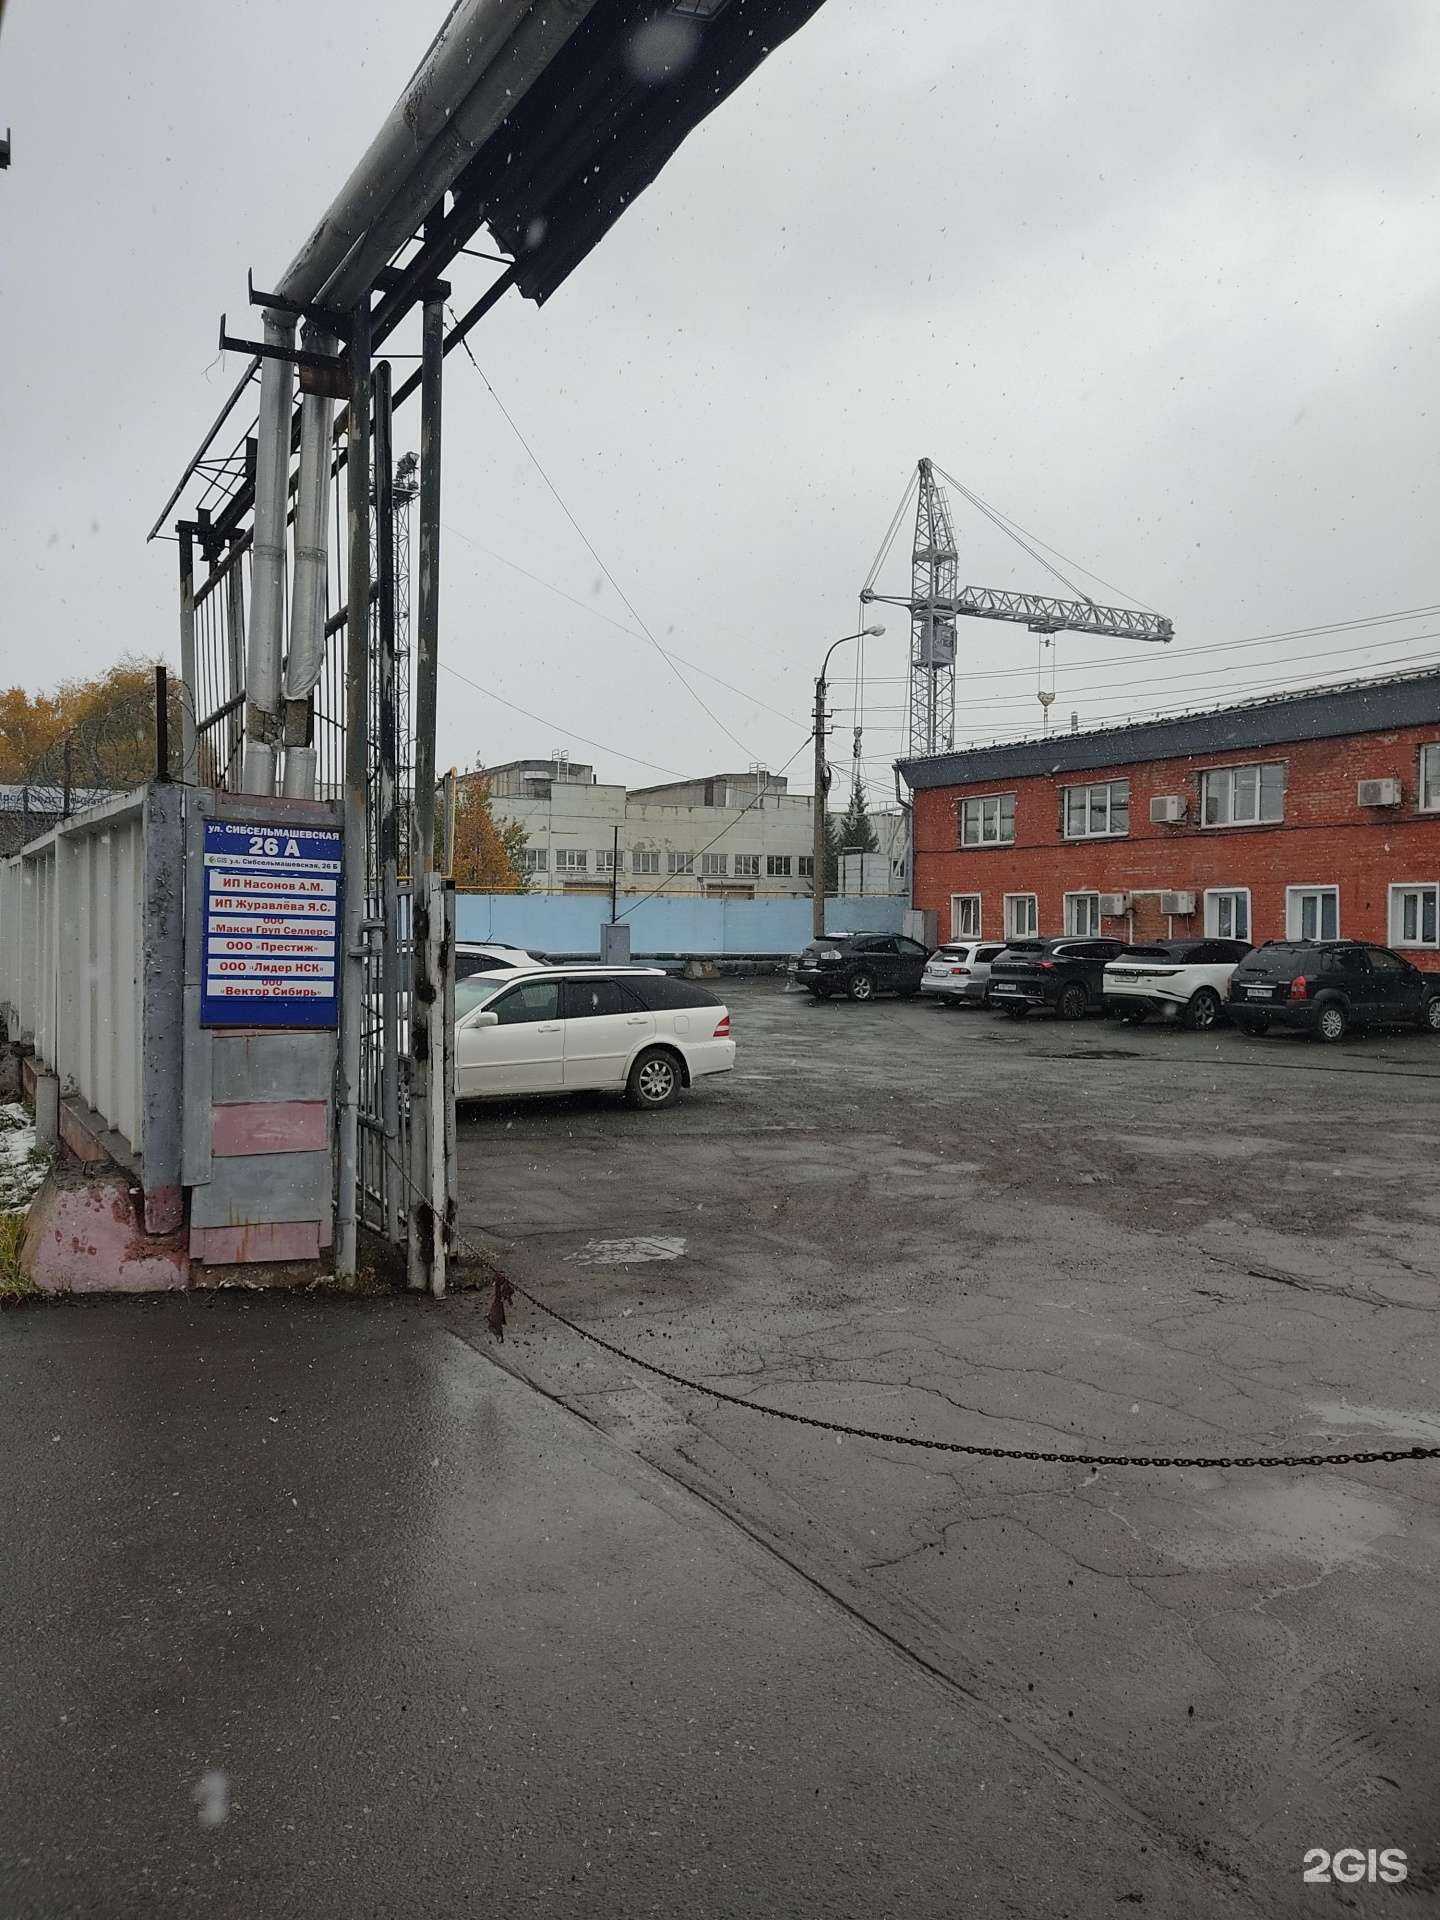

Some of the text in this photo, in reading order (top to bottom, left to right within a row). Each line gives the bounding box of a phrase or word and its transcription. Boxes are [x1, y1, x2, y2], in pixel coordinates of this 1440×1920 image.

[207, 825, 339, 841] ул. СИБСЕЛЬМАШЕВСКАЯ
[249, 837, 300, 857] 26 А
[223, 878, 324, 891] ИП Насонов А.М.
[215, 899, 331, 912] ИП Журавлёва Я.С.
[256, 926, 280, 934] Груп
[226, 941, 253, 950] ООО
[220, 962, 246, 971] ООО
